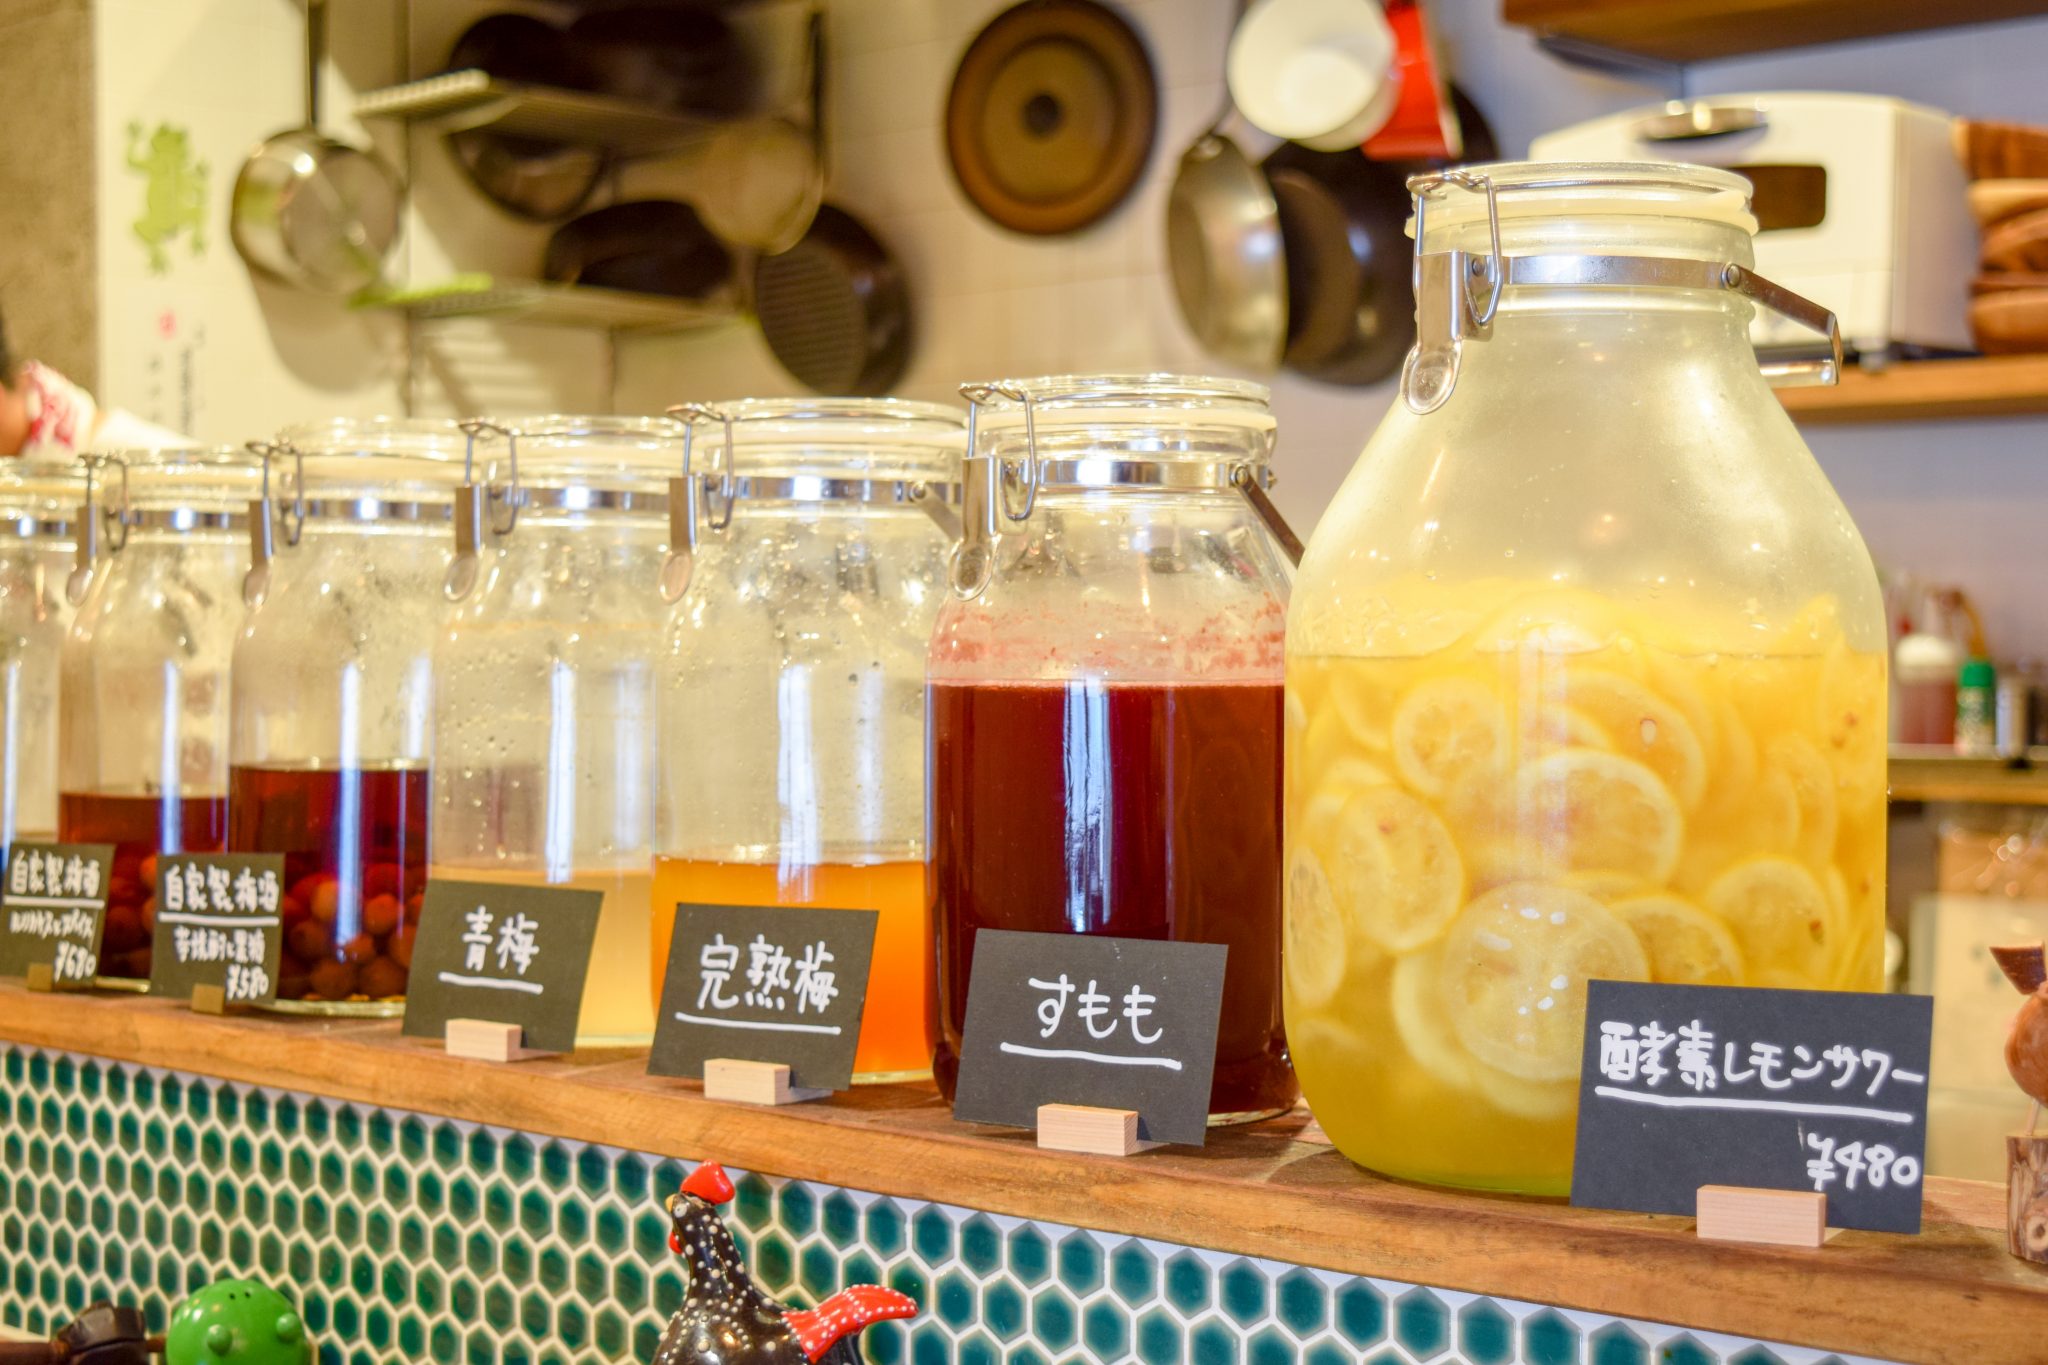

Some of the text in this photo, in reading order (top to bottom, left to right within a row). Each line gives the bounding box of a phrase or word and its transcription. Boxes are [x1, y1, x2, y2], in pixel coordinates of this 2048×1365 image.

[462, 904, 540, 975] 青梅
[696, 932, 839, 1014] 完熟梅
[1028, 973, 1163, 1045] すもも
[1600, 1018, 1925, 1096] 酵素レモンサワー
[1806, 1130, 1919, 1192] ¥480
